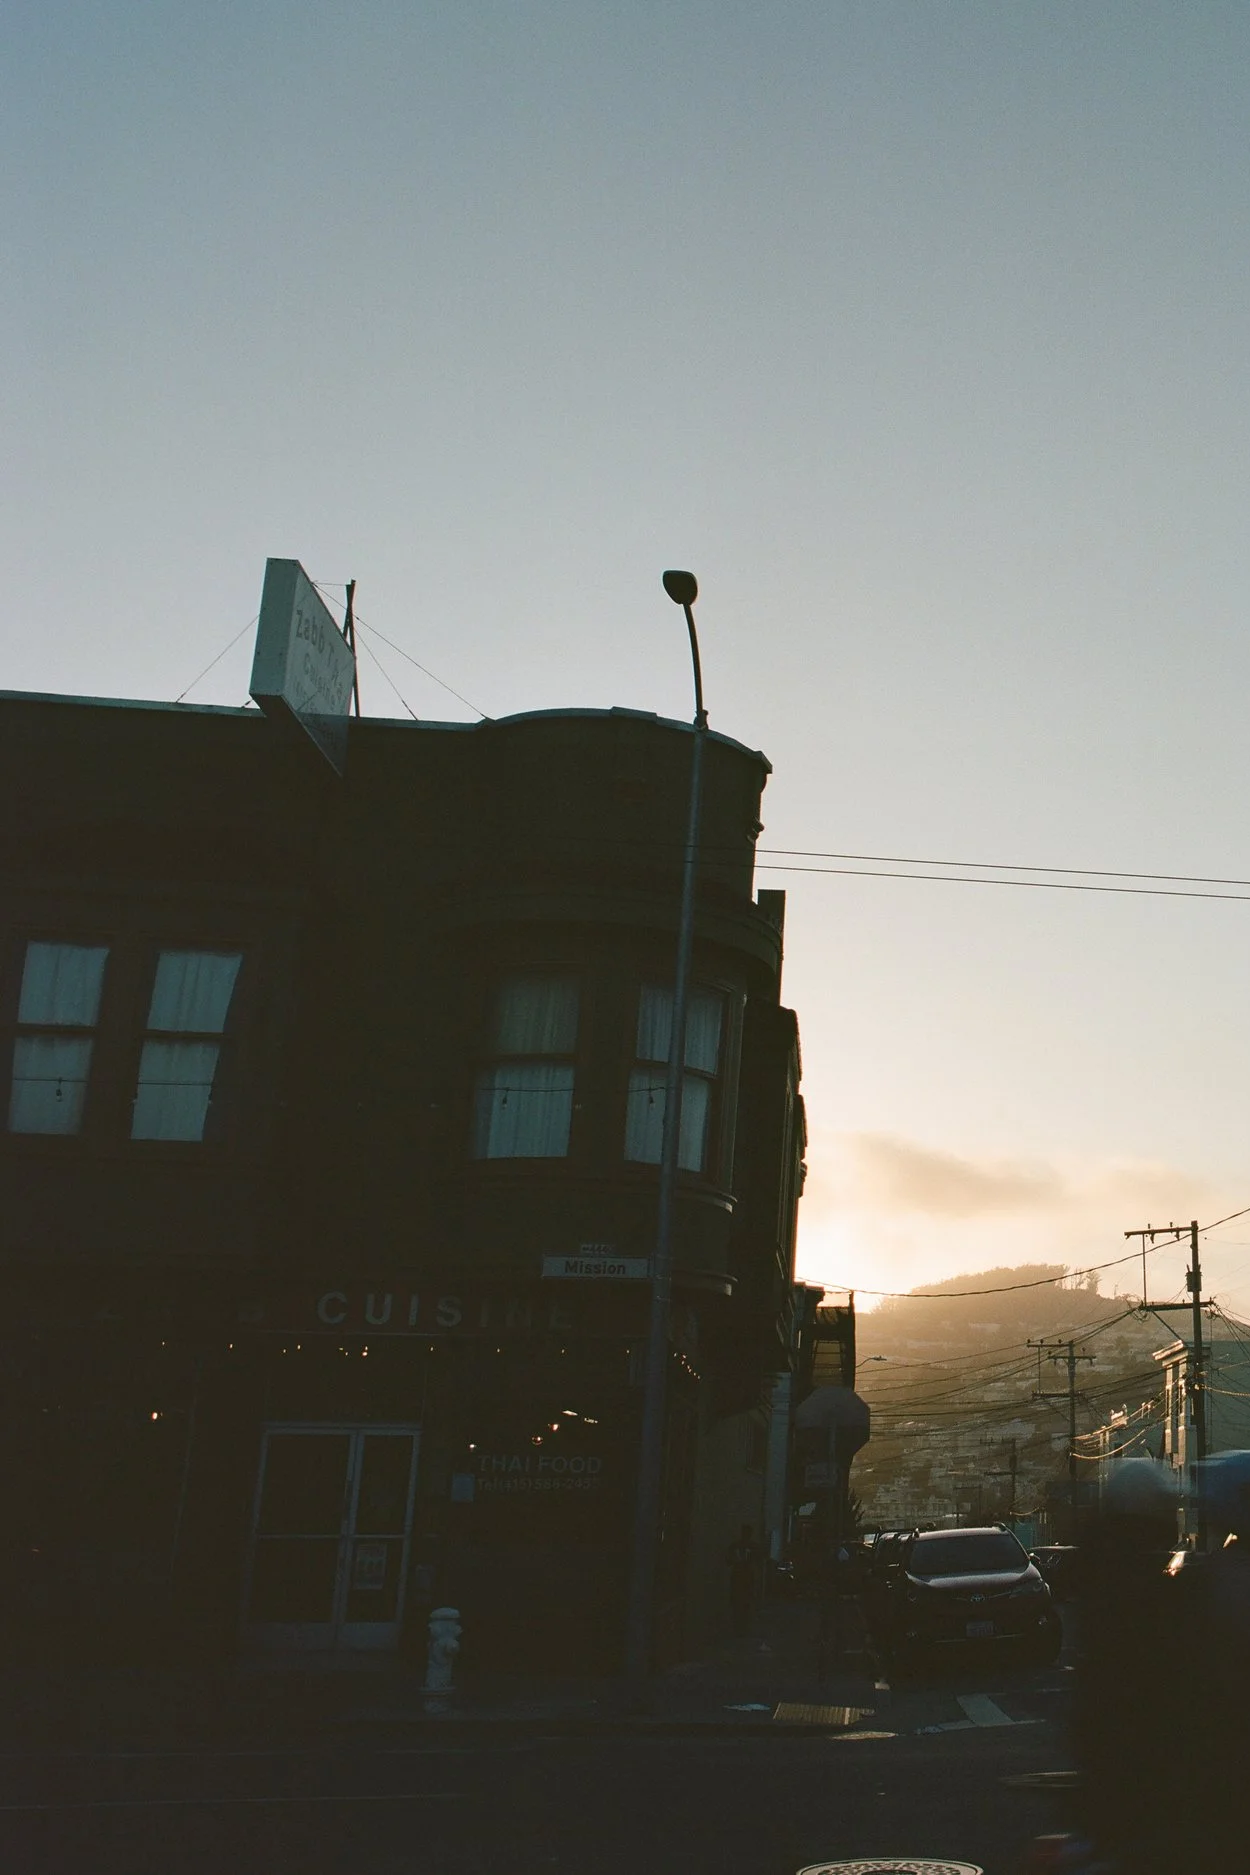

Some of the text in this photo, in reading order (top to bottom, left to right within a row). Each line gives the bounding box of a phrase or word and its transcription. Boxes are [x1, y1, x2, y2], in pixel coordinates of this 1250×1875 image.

[296, 609, 324, 654] Zabb
[565, 1261, 626, 1275] Mission
[317, 1290, 572, 1330] CUISINE
[478, 1454, 602, 1474] THAI FOOD
